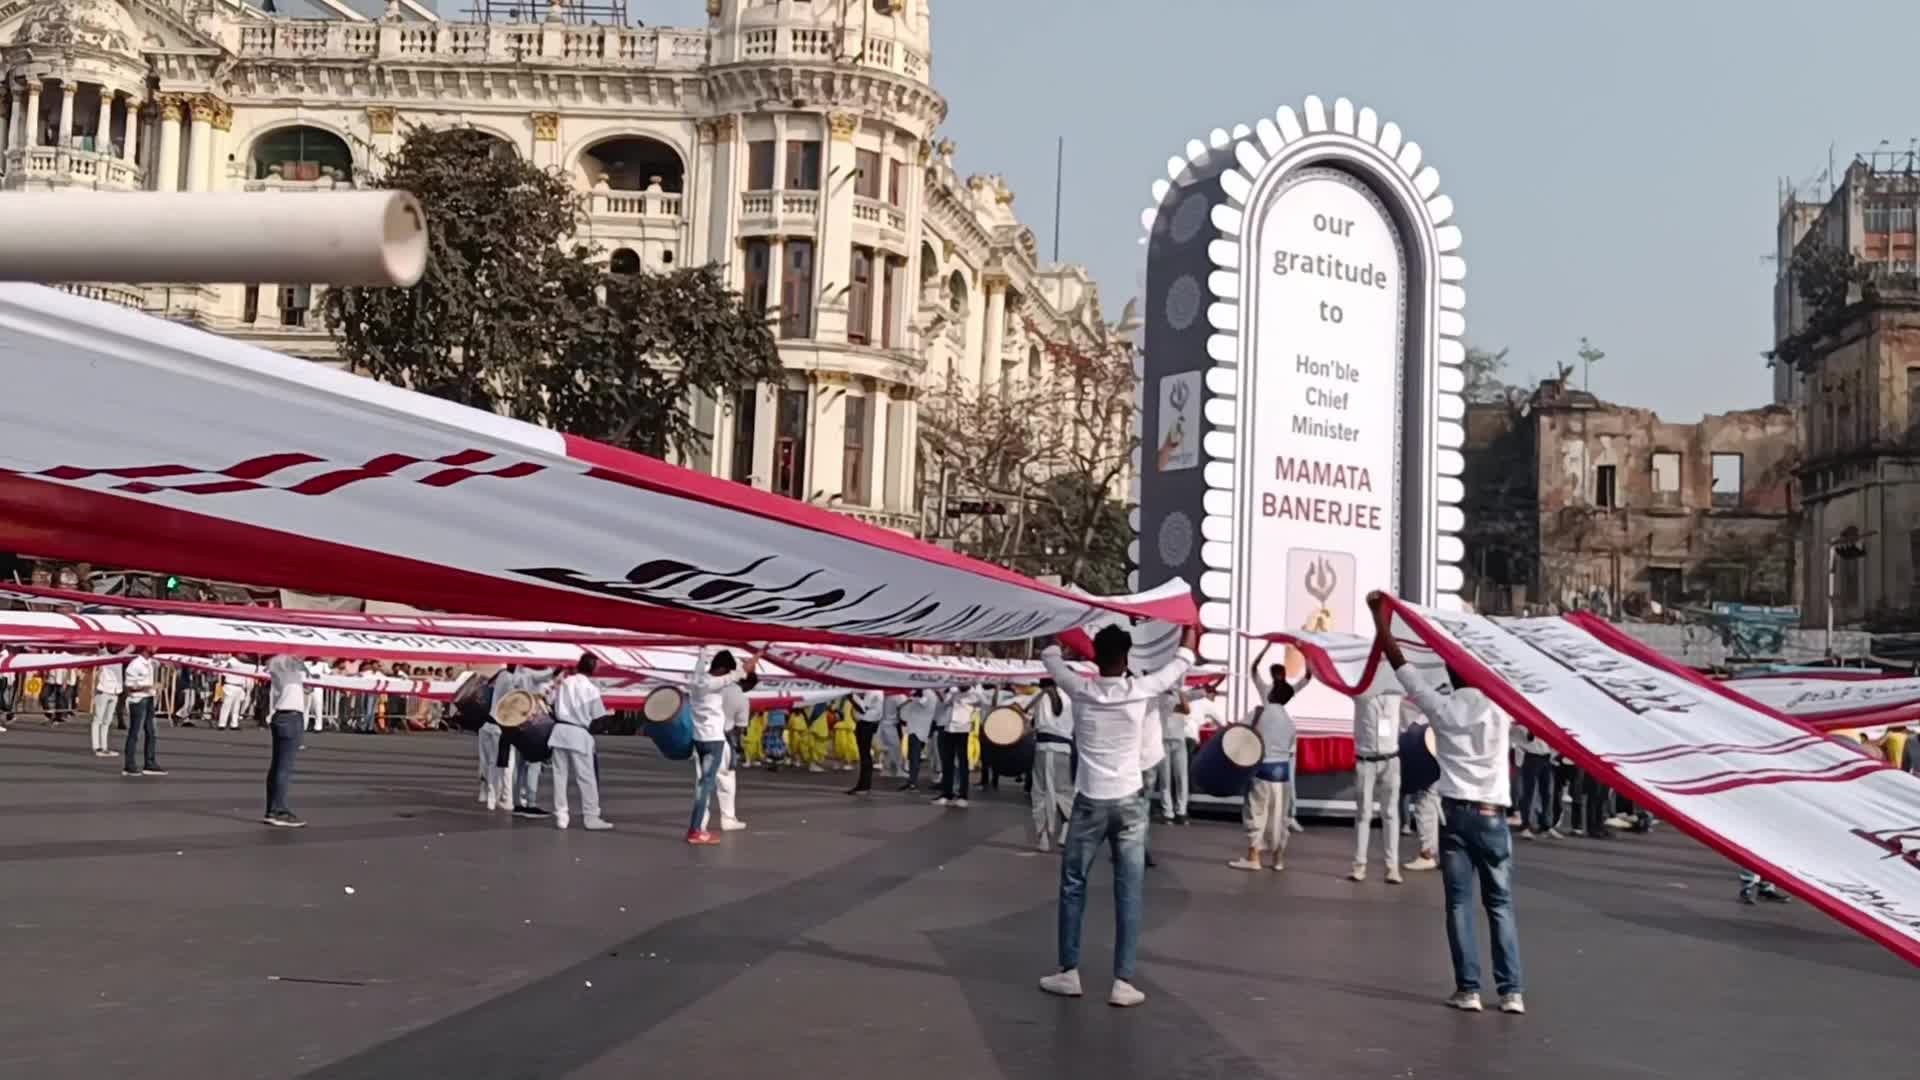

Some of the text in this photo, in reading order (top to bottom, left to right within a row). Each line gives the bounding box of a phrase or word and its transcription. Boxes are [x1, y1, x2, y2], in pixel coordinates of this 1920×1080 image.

[1313, 213, 1355, 238] our
[1272, 249, 1387, 290] gratitude
[1319, 299, 1343, 324] to
[1296, 353, 1360, 383] Hon'ble
[1305, 386, 1349, 411] Chief
[1291, 414, 1360, 443] Minister
[1275, 455, 1372, 493] MAMATA
[1261, 491, 1382, 532] BANERJEE
